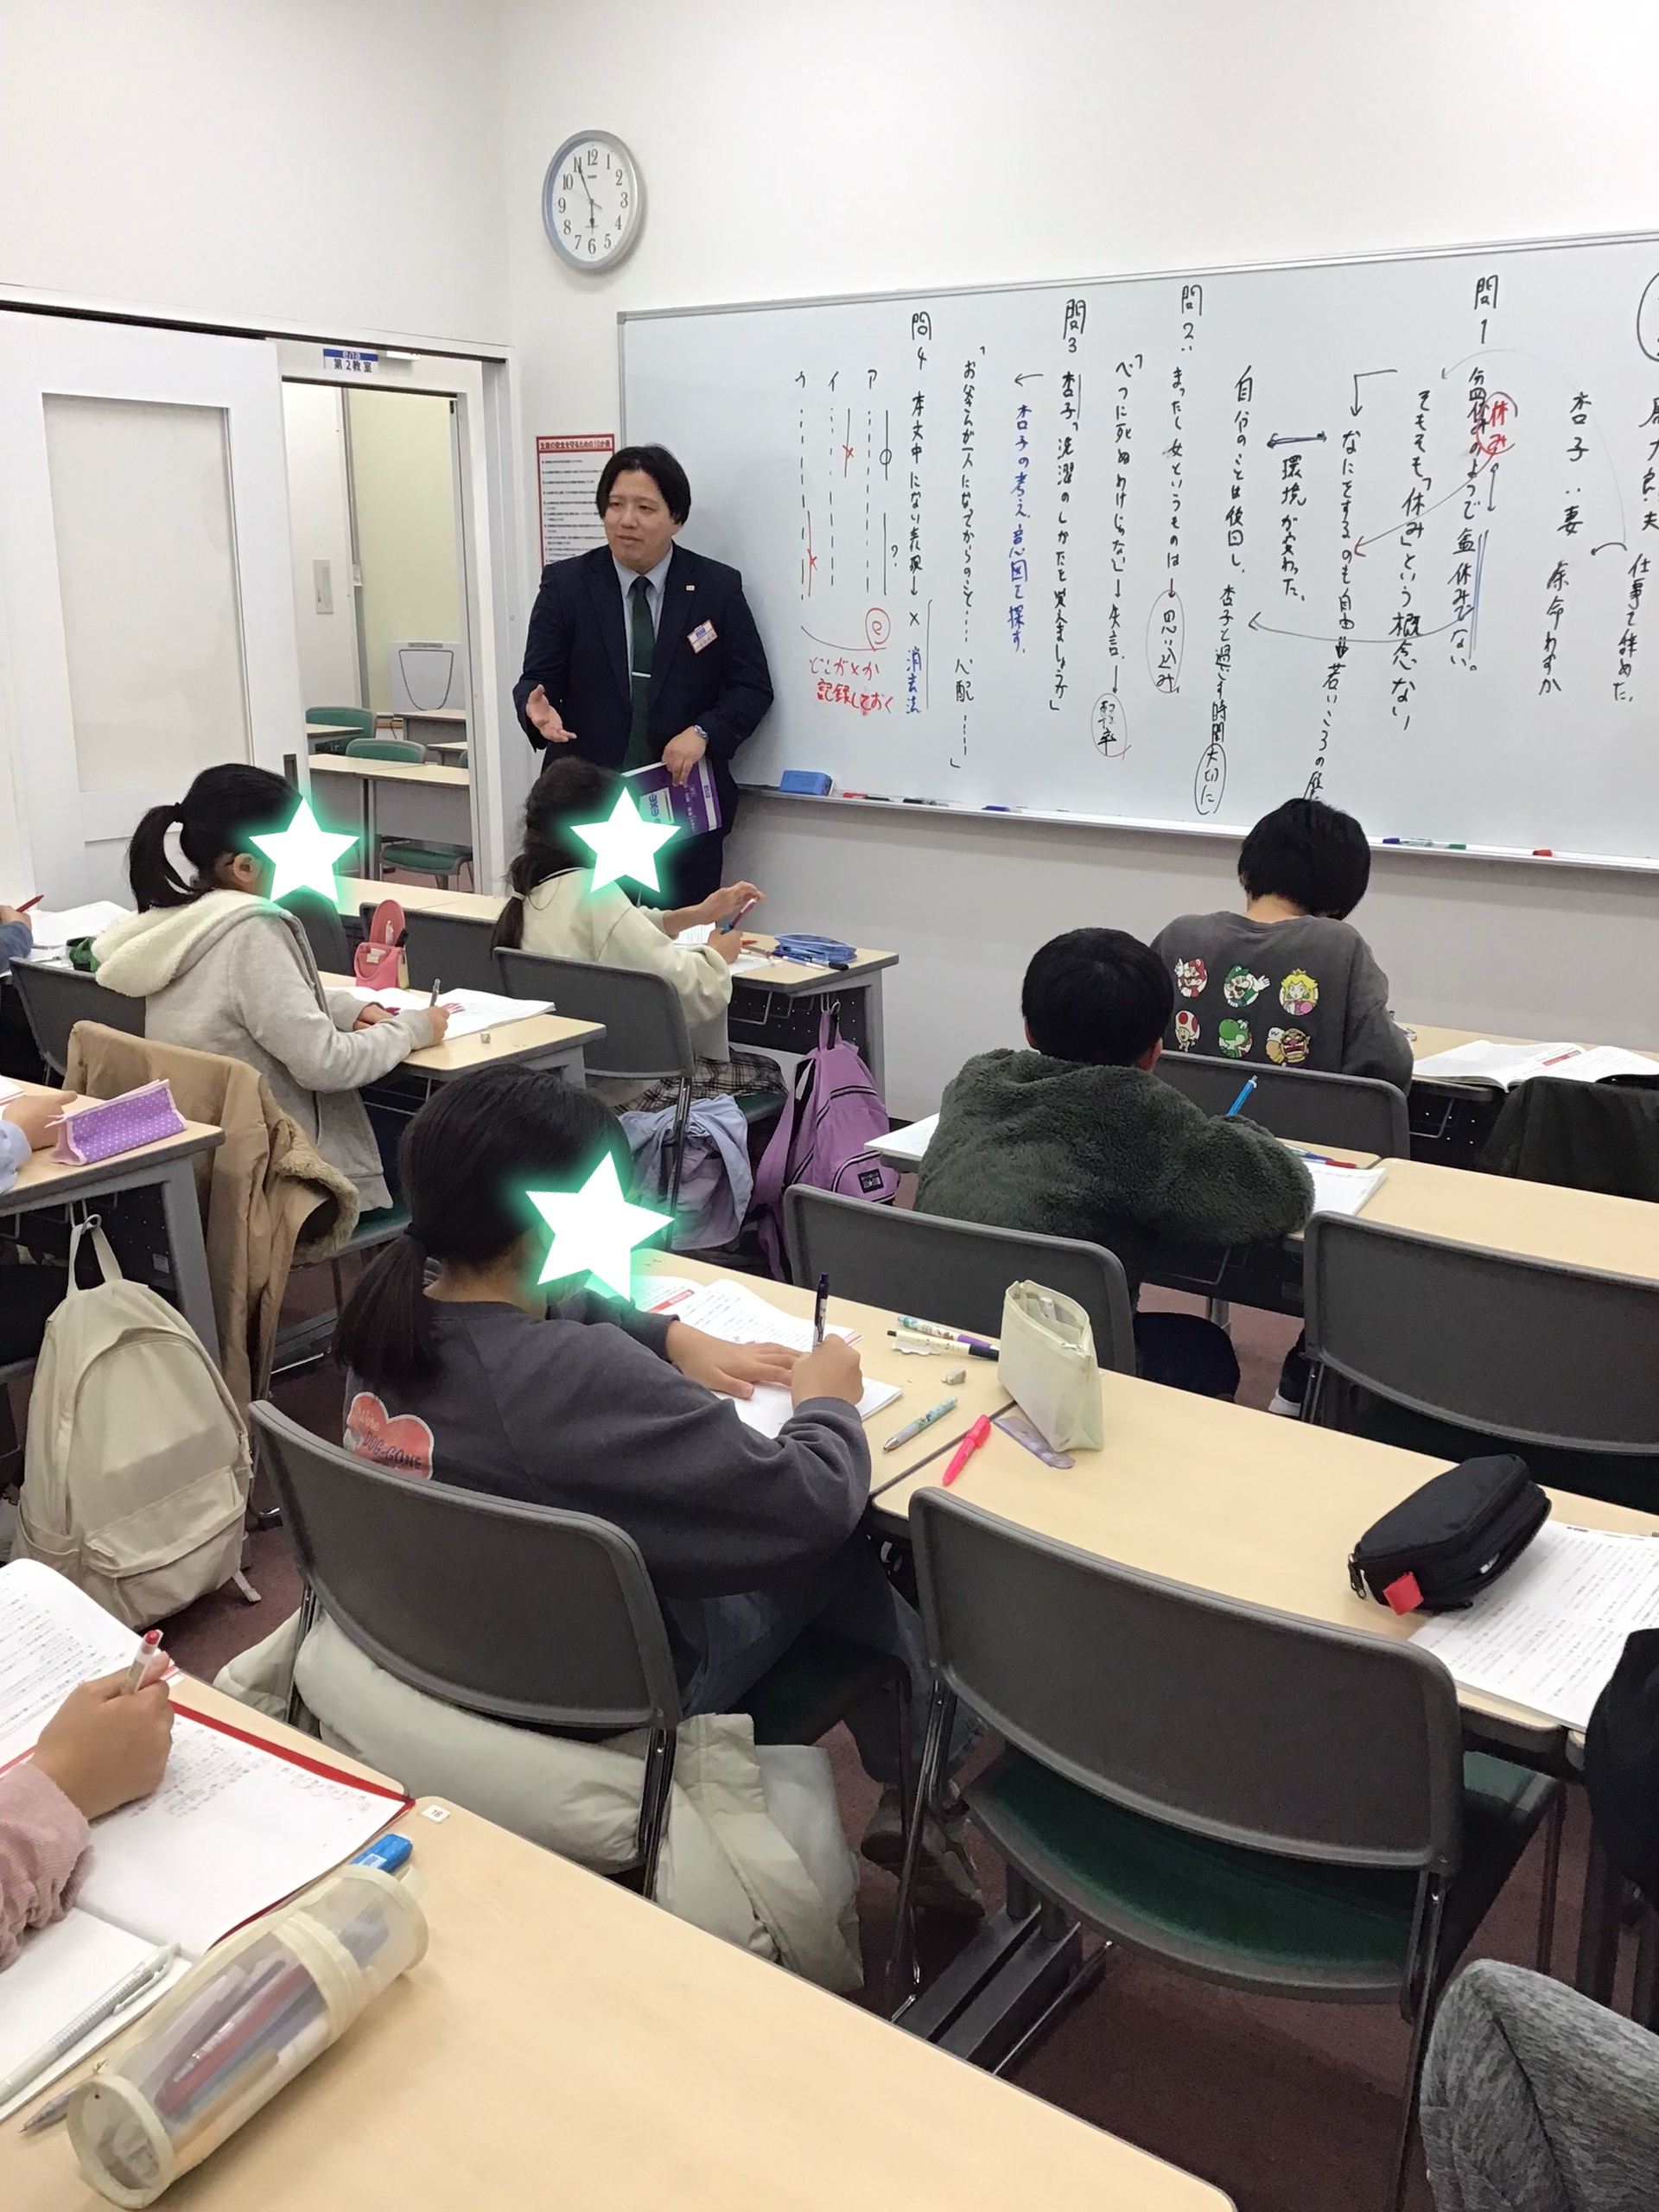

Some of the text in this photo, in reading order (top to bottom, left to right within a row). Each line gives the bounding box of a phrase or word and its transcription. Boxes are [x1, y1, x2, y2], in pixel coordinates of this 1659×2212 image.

[588, 149, 599, 166] 12
[607, 154, 611, 170] 1
[563, 174, 574, 190] 10
[615, 168, 623, 186] 2
[557, 198, 567, 213] 9
[620, 192, 628, 208] 3
[563, 219, 572, 235] 8
[614, 214, 622, 231] 4
[575, 235, 582, 250] 7
[588, 238, 596, 254] 6
[604, 233, 612, 249] 5
[1473, 274, 1499, 345] 問1
[1063, 299, 1086, 353] 問3
[911, 311, 931, 370] 問4
[342, 351, 361, 359] ena
[334, 359, 372, 373] 第2教室
[828, 371, 839, 392] イ
[868, 369, 878, 390] ア
[1486, 400, 1509, 453] 休み
[906, 646, 922, 715] 消去法
[817, 677, 894, 715] 記録しておく
[363, 1432, 423, 1470] DOG-GONE
